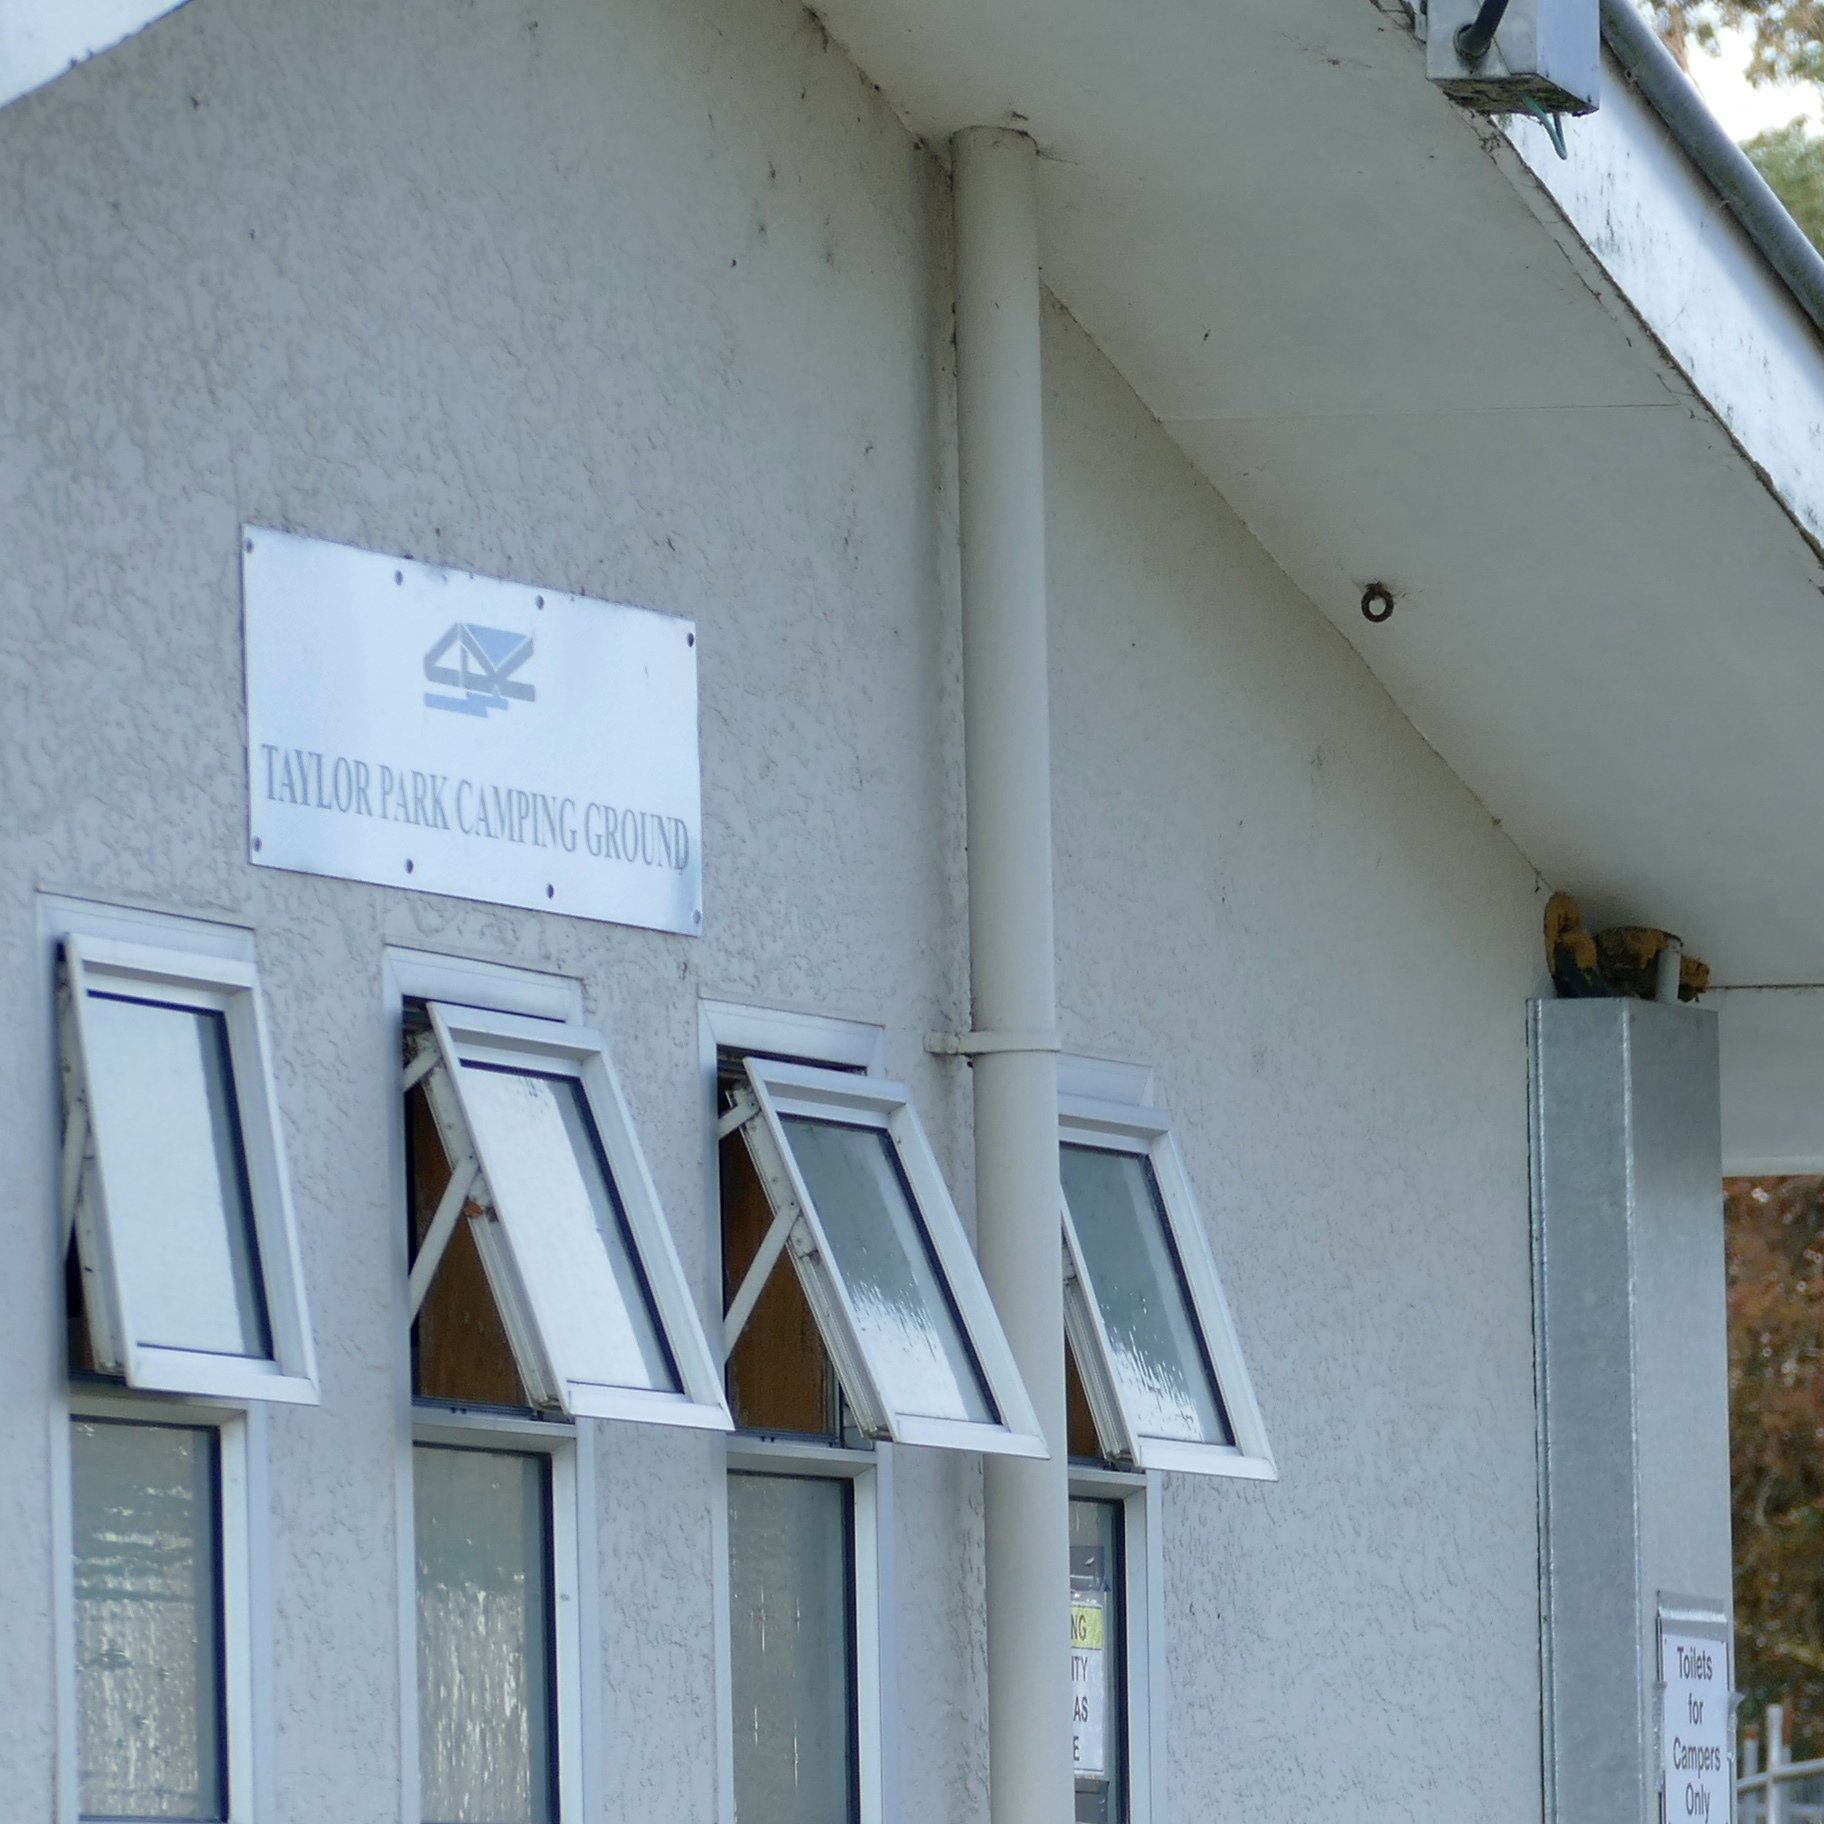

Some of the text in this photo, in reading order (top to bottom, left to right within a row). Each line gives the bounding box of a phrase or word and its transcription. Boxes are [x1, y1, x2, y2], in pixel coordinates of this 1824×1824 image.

[261, 743, 690, 871] TAYLOR PARK CAMPING GROUND
[1677, 1646, 1713, 1681] Toilets
[1688, 1692, 1704, 1725] for
[1673, 1736, 1721, 1779] Campers
[1685, 1783, 1711, 1824] Only
